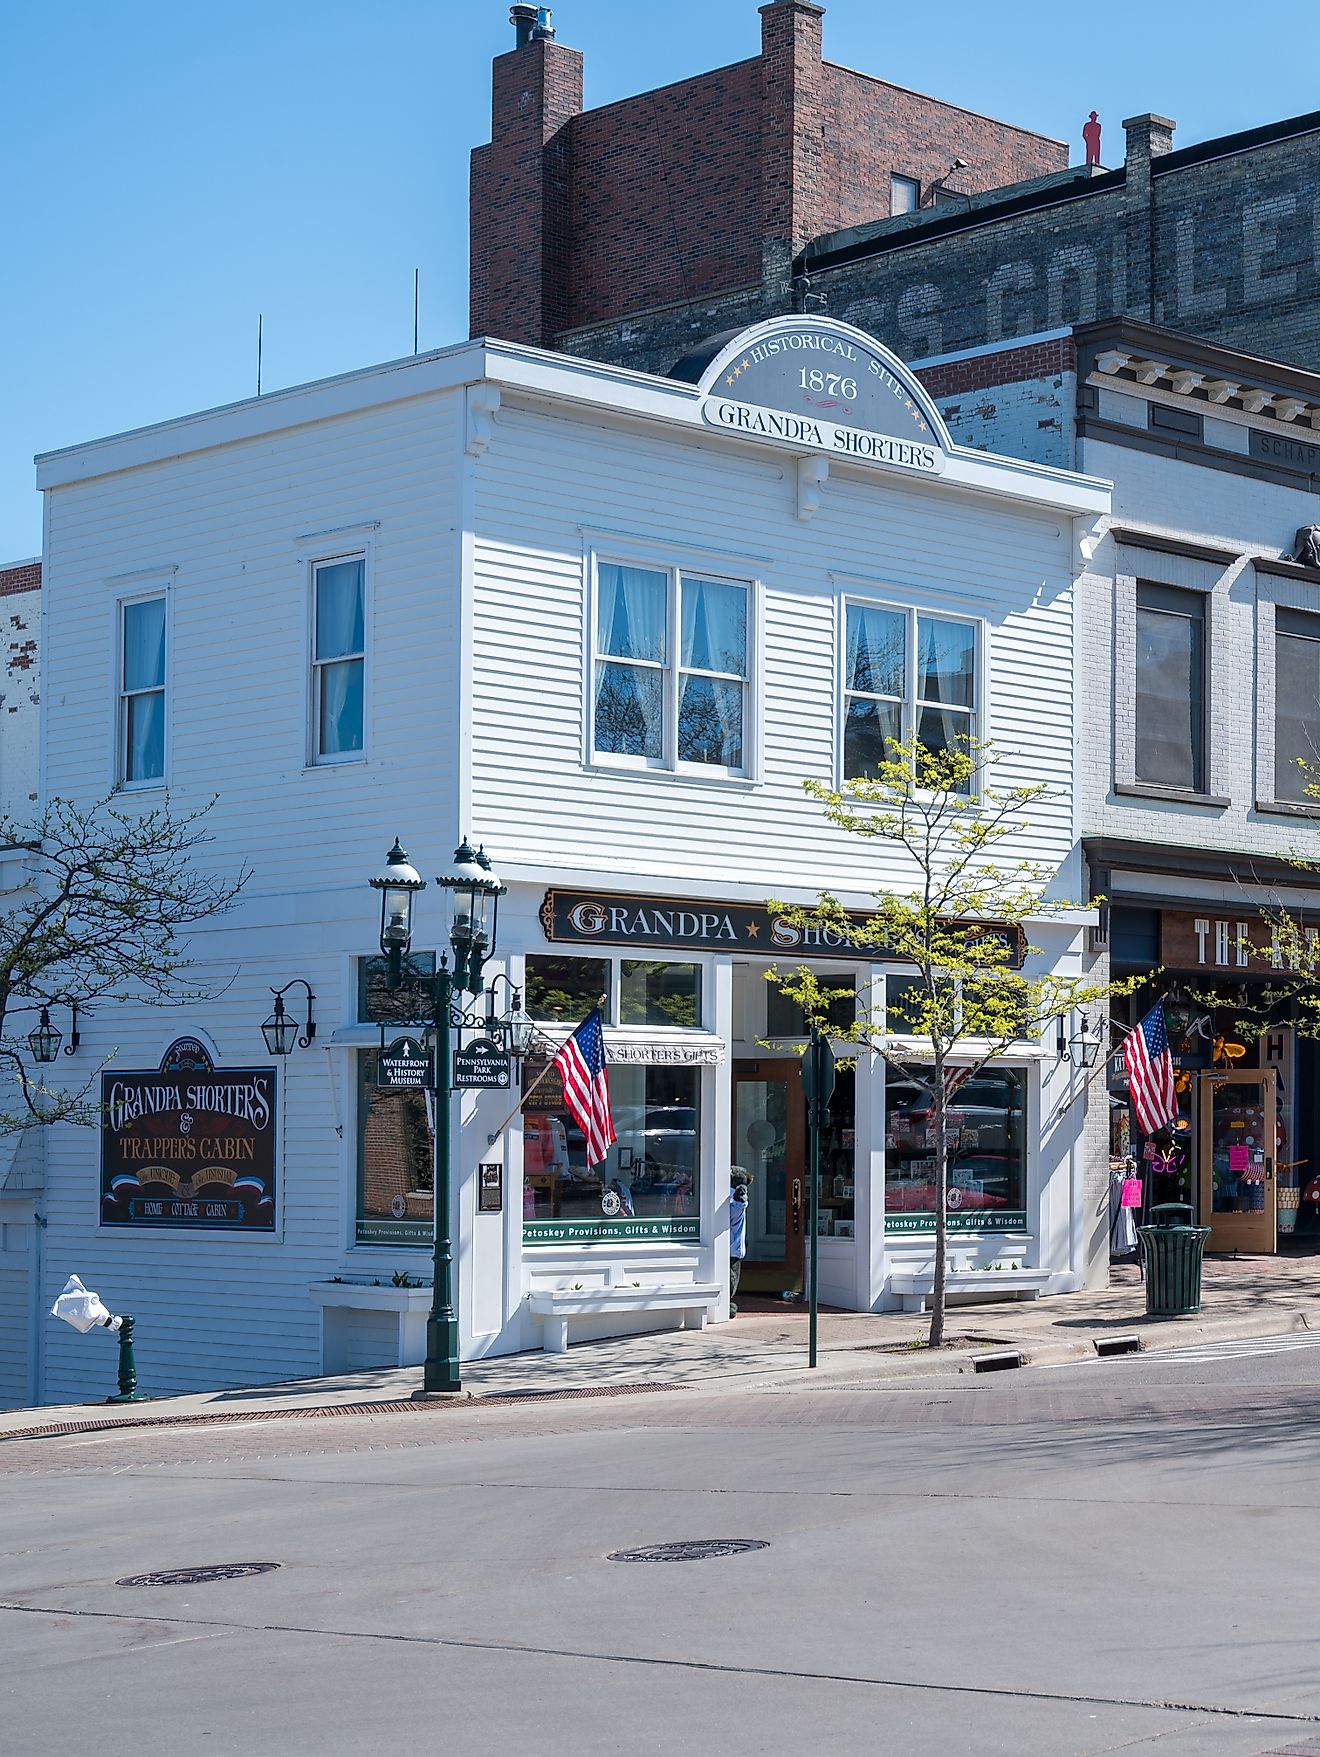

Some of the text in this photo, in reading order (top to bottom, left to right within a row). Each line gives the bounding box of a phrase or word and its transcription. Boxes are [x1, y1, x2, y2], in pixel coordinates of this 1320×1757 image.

[749, 335, 907, 401] HISTORICAL SITE
[798, 366, 859, 401] 1876
[717, 402, 936, 470] GRANDPA SHORTER'S
[567, 901, 739, 941] GRANDPA
[769, 914, 926, 955] SHORE'S
[1194, 918, 1249, 967] THE
[616, 1048, 680, 1061] SHORTER'S
[684, 1049, 718, 1061] GIFTS
[382, 1058, 429, 1068] WATERFRONT
[456, 1057, 508, 1067] PENNSYLVANIA
[394, 1068, 425, 1078] HISTORY
[473, 1066, 491, 1074] PARK
[390, 1077, 421, 1085] MUSEUM
[456, 1074, 497, 1083] RESTROOMS
[109, 1075, 270, 1132] GRANDPA SHORTER'S
[179, 1112, 194, 1134] &
[119, 1134, 256, 1160] TRAPPER'S CABIN
[144, 1202, 228, 1217] HOME COTTAGE CABIN
[883, 1219, 917, 1230] Petoskey
[919, 1218, 963, 1228] Provons,
[965, 1218, 985, 1226] Gifts
[995, 1217, 1023, 1226] Wisdom
[522, 1224, 696, 1238] Petoskey Provisions, Gifts & Wisdom
